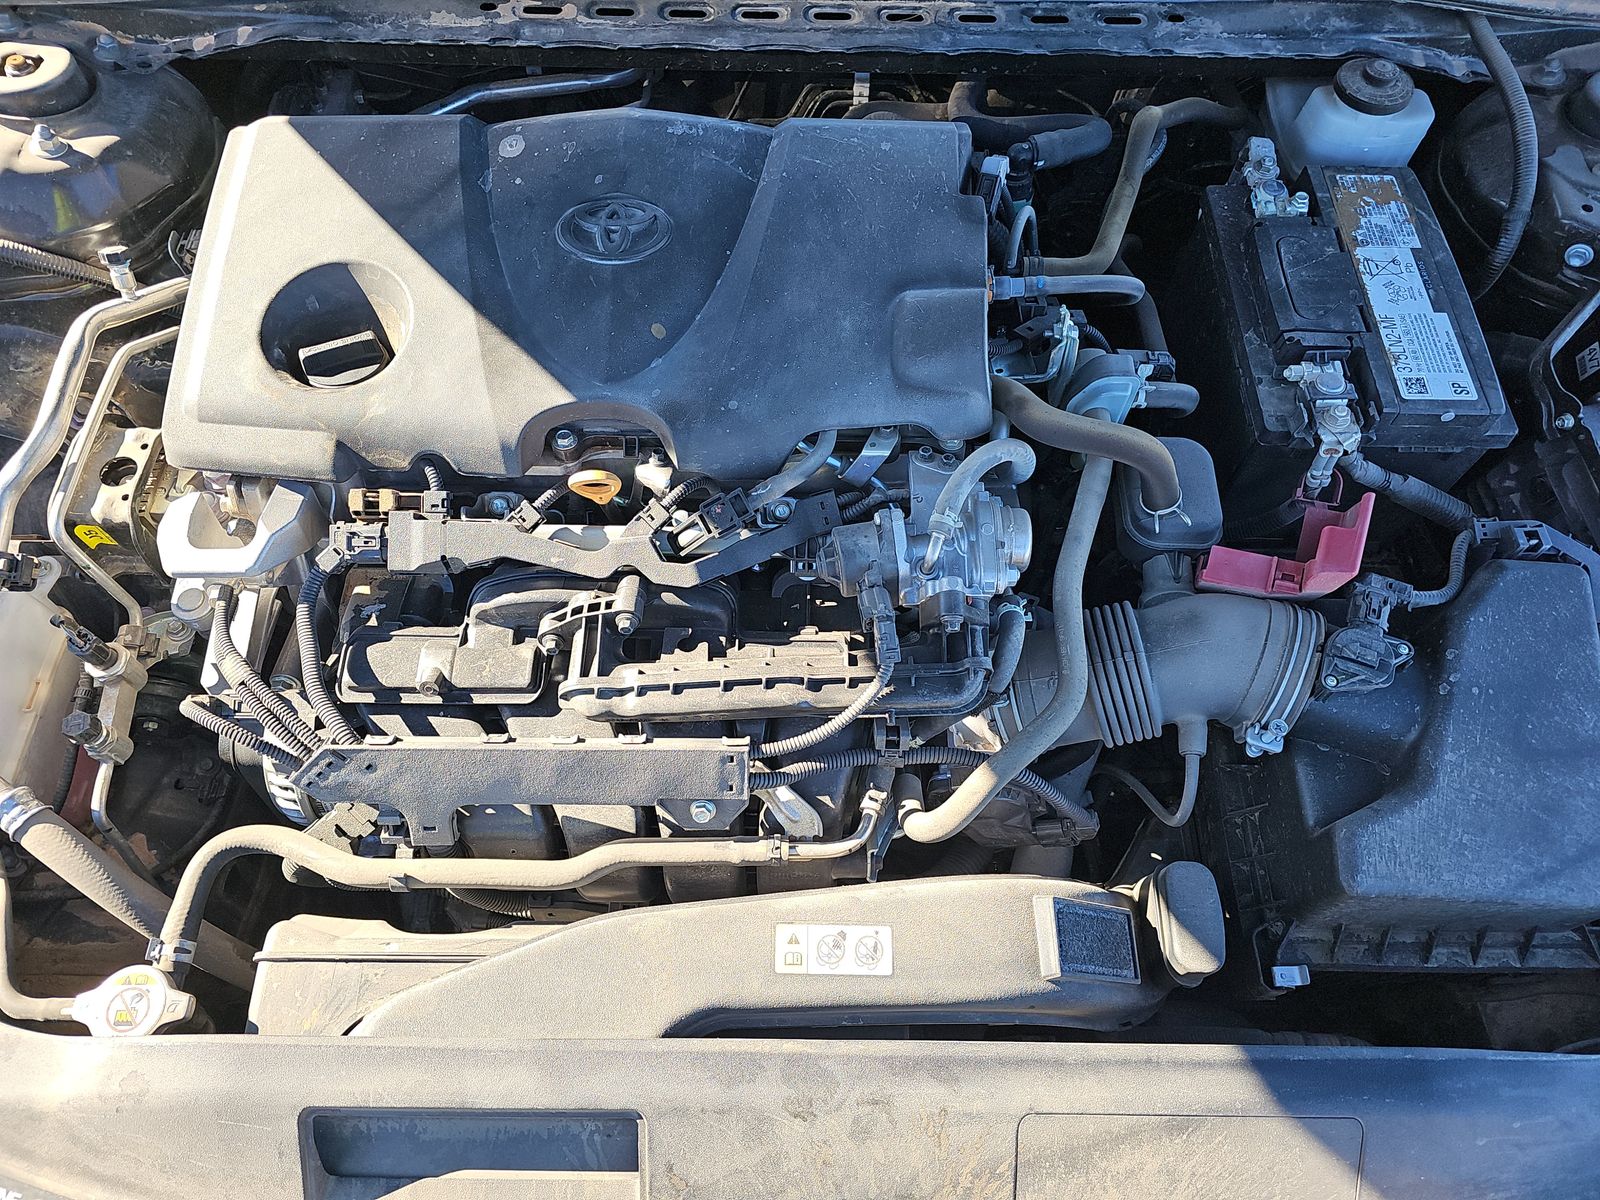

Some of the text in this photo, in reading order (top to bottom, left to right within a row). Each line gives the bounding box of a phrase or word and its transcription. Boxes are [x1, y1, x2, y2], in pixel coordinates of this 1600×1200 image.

[1404, 262, 1414, 272] Pb
[1418, 261, 1432, 288] CLARIOS
[1377, 314, 1413, 372] 375LN2-MF
[1587, 348, 1599, 369] 4V7
[1451, 382, 1469, 394] SP
